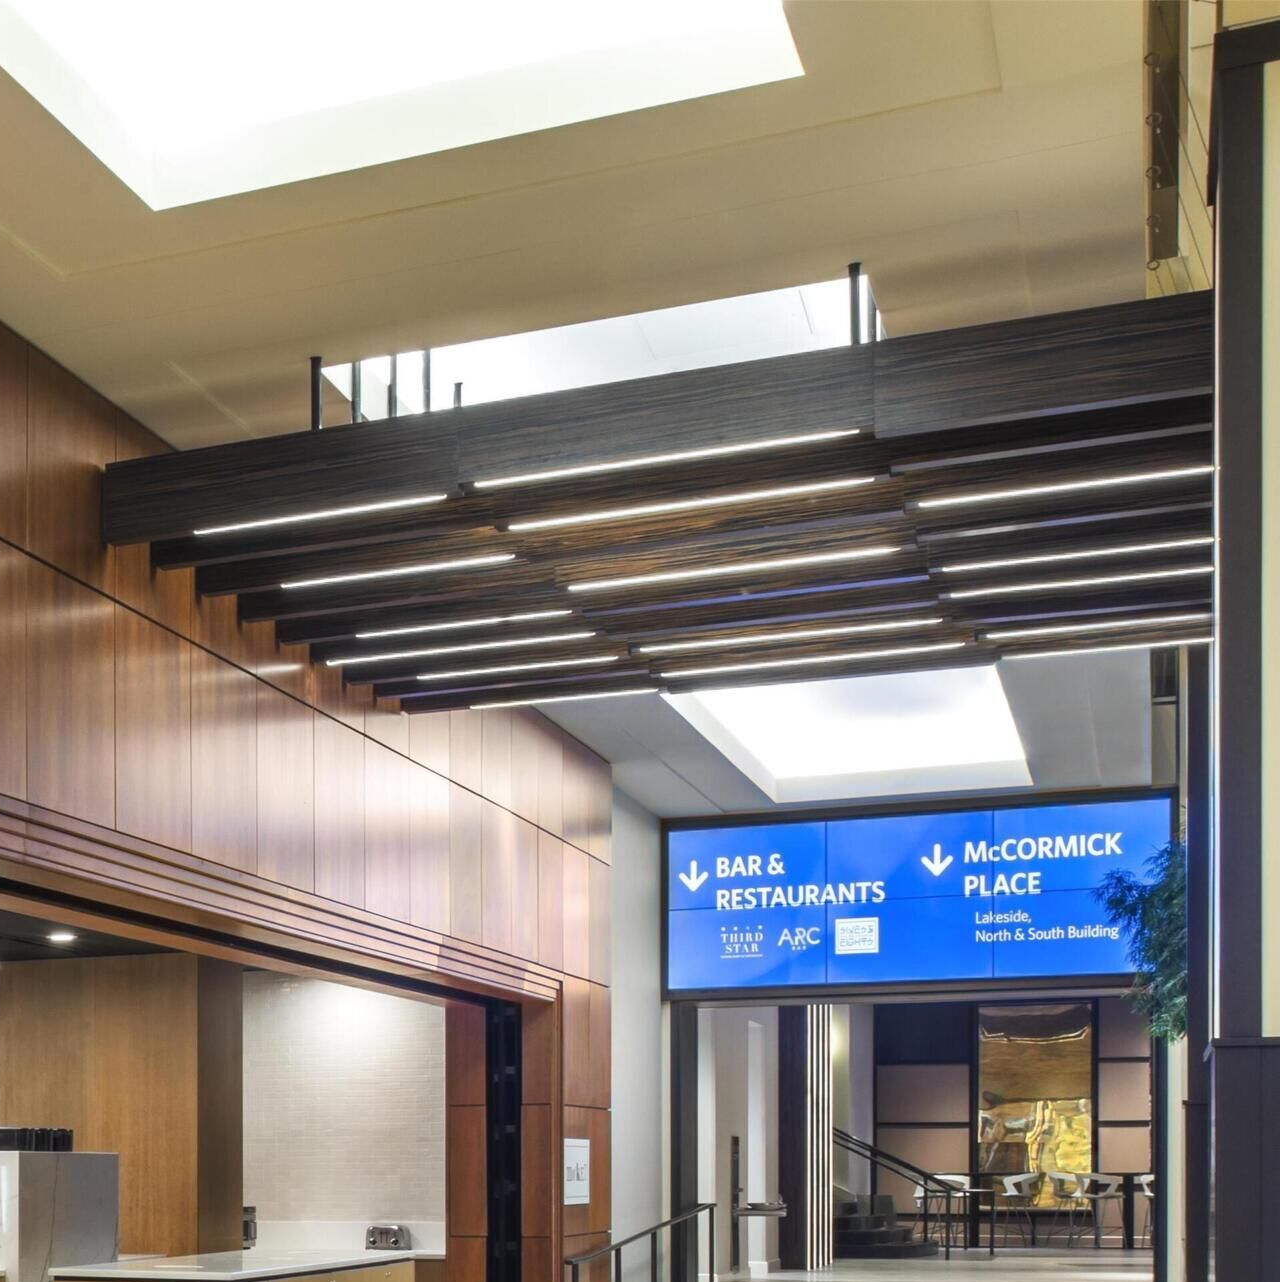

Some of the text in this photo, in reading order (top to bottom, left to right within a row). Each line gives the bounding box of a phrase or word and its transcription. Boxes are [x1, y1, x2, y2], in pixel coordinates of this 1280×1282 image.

[963, 832, 1123, 863] McCORMICK
[716, 853, 785, 878] BAR &
[964, 872, 1042, 898] PLACE
[716, 881, 886, 911] RESTAURANTS
[975, 910, 1032, 924] Lakeside,
[721, 932, 764, 943] THIRD
[777, 927, 821, 946] ARC
[975, 924, 1120, 943] North & South Building
[725, 943, 759, 954] STAR
